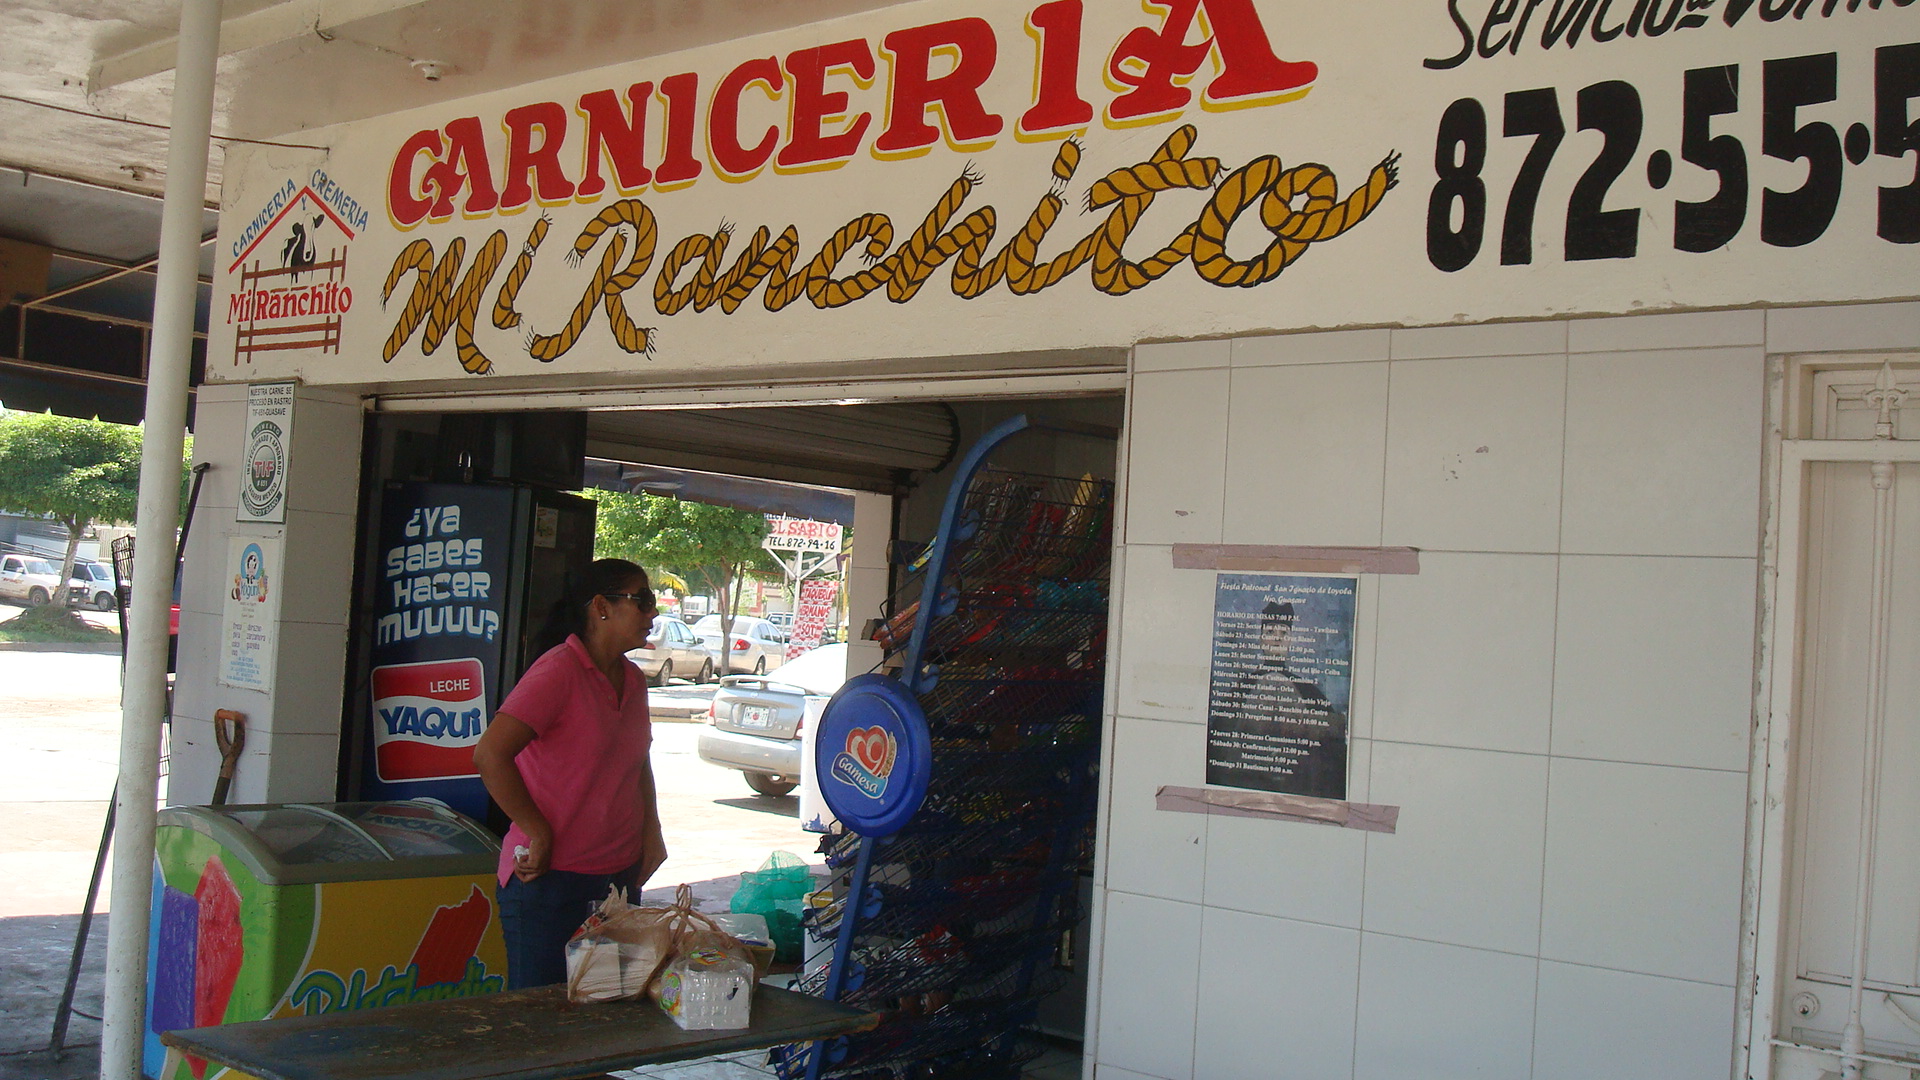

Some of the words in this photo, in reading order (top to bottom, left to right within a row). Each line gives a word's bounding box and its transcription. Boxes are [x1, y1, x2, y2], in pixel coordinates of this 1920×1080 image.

[300, 195, 307, 211] Y
[311, 168, 369, 232] CREMERIA
[232, 178, 297, 258] CARNICERIA
[380, 209, 553, 376] Mi
[524, 124, 1400, 360] Ranchito
[226, 289, 251, 324] Mi
[254, 281, 353, 322] Ranchito
[250, 388, 268, 396] NUESTRA
[269, 386, 284, 395] CARNE
[286, 386, 292, 394] SE
[268, 397, 274, 406] EN
[274, 396, 292, 405] RASTRO
[254, 460, 274, 478] TIF
[788, 522, 838, 538] SABIO
[769, 536, 785, 546] TEL.
[1221, 582, 1240, 590] Fiesta
[1274, 584, 1288, 592] San
[1317, 586, 1327, 594] de
[1217, 611, 1246, 619] HORARIO
[1216, 640, 1238, 649] Domingo
[1214, 660, 1232, 668] Martes
[1242, 662, 1259, 670] Sector
[1248, 672, 1264, 680] Sector
[429, 678, 471, 694] LECHE
[1212, 690, 1232, 698] Viernes
[1242, 692, 1259, 700] Sector
[1241, 702, 1258, 710] Sector
[1211, 710, 1235, 719] Domingo
[1241, 732, 1264, 740] Primeras
[838, 756, 879, 794] Gamesa
